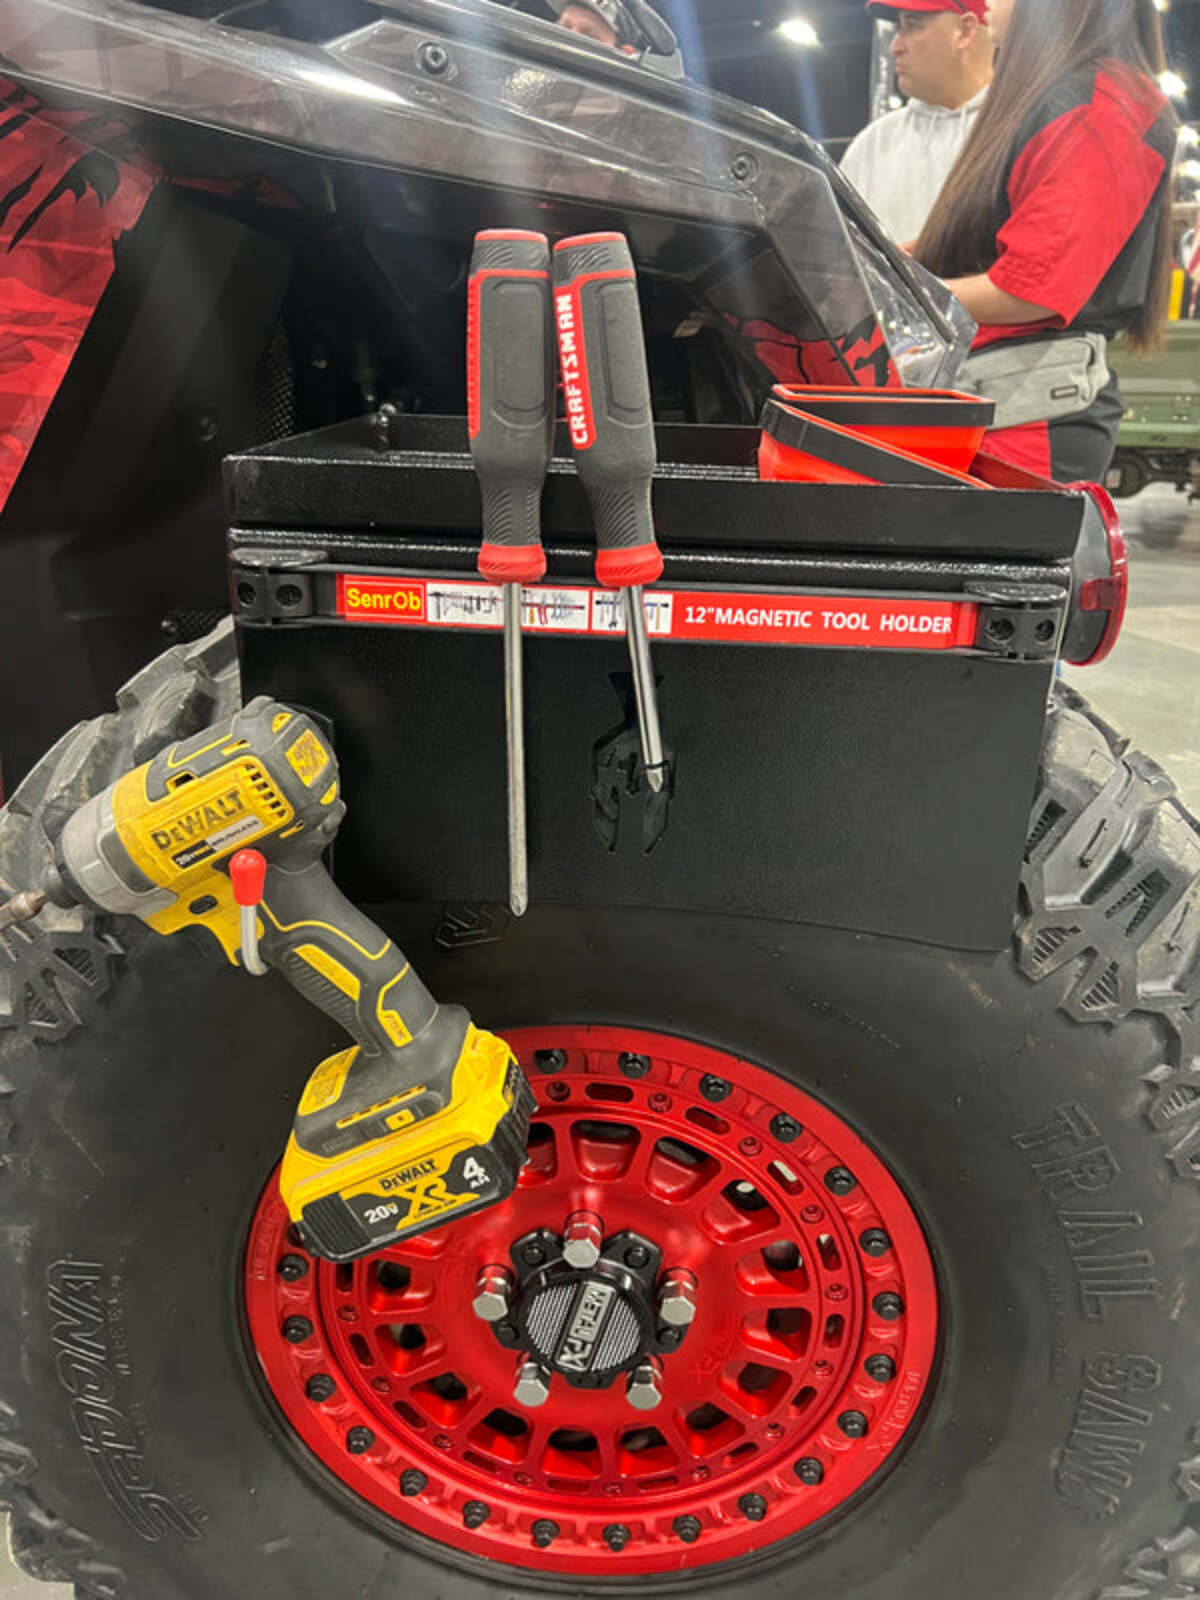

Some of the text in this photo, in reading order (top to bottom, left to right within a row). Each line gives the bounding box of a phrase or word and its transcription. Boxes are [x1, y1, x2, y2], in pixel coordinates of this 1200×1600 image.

[556, 294, 588, 445] CRAFTSMAN
[347, 587, 422, 611] SenrOb
[822, 611, 870, 632] TOOL
[880, 614, 952, 635] HOLDER
[462, 1156, 485, 1180] 4
